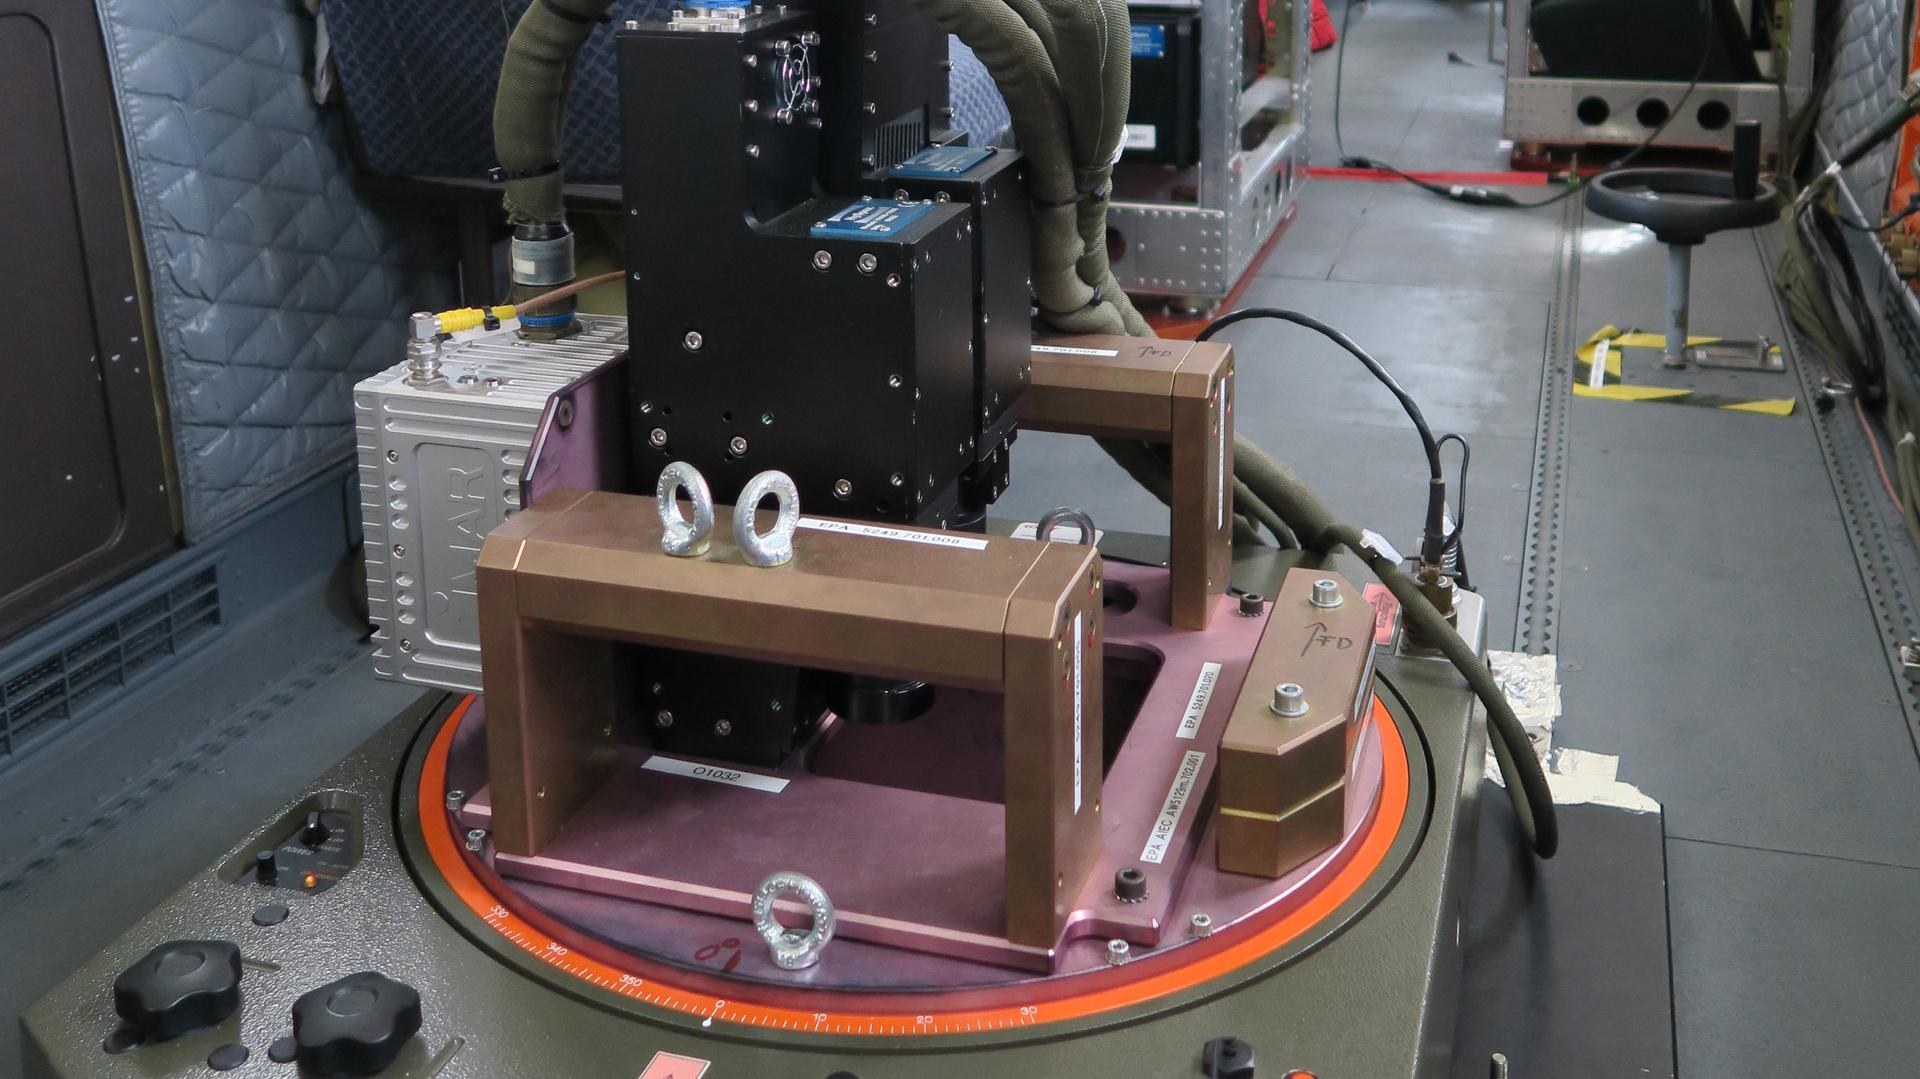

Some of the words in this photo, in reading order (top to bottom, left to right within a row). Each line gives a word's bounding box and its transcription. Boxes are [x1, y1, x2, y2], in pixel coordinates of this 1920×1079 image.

[818, 522, 848, 531] EPA
[1184, 715, 1199, 729] EPA
[1145, 844, 1162, 862] EPA
[1156, 818, 1173, 841] AIEC
[546, 942, 568, 956] 340
[619, 974, 643, 987] 350
[812, 1013, 828, 1023] 10
[916, 1015, 934, 1024] 20
[1020, 1006, 1038, 1016] 30
